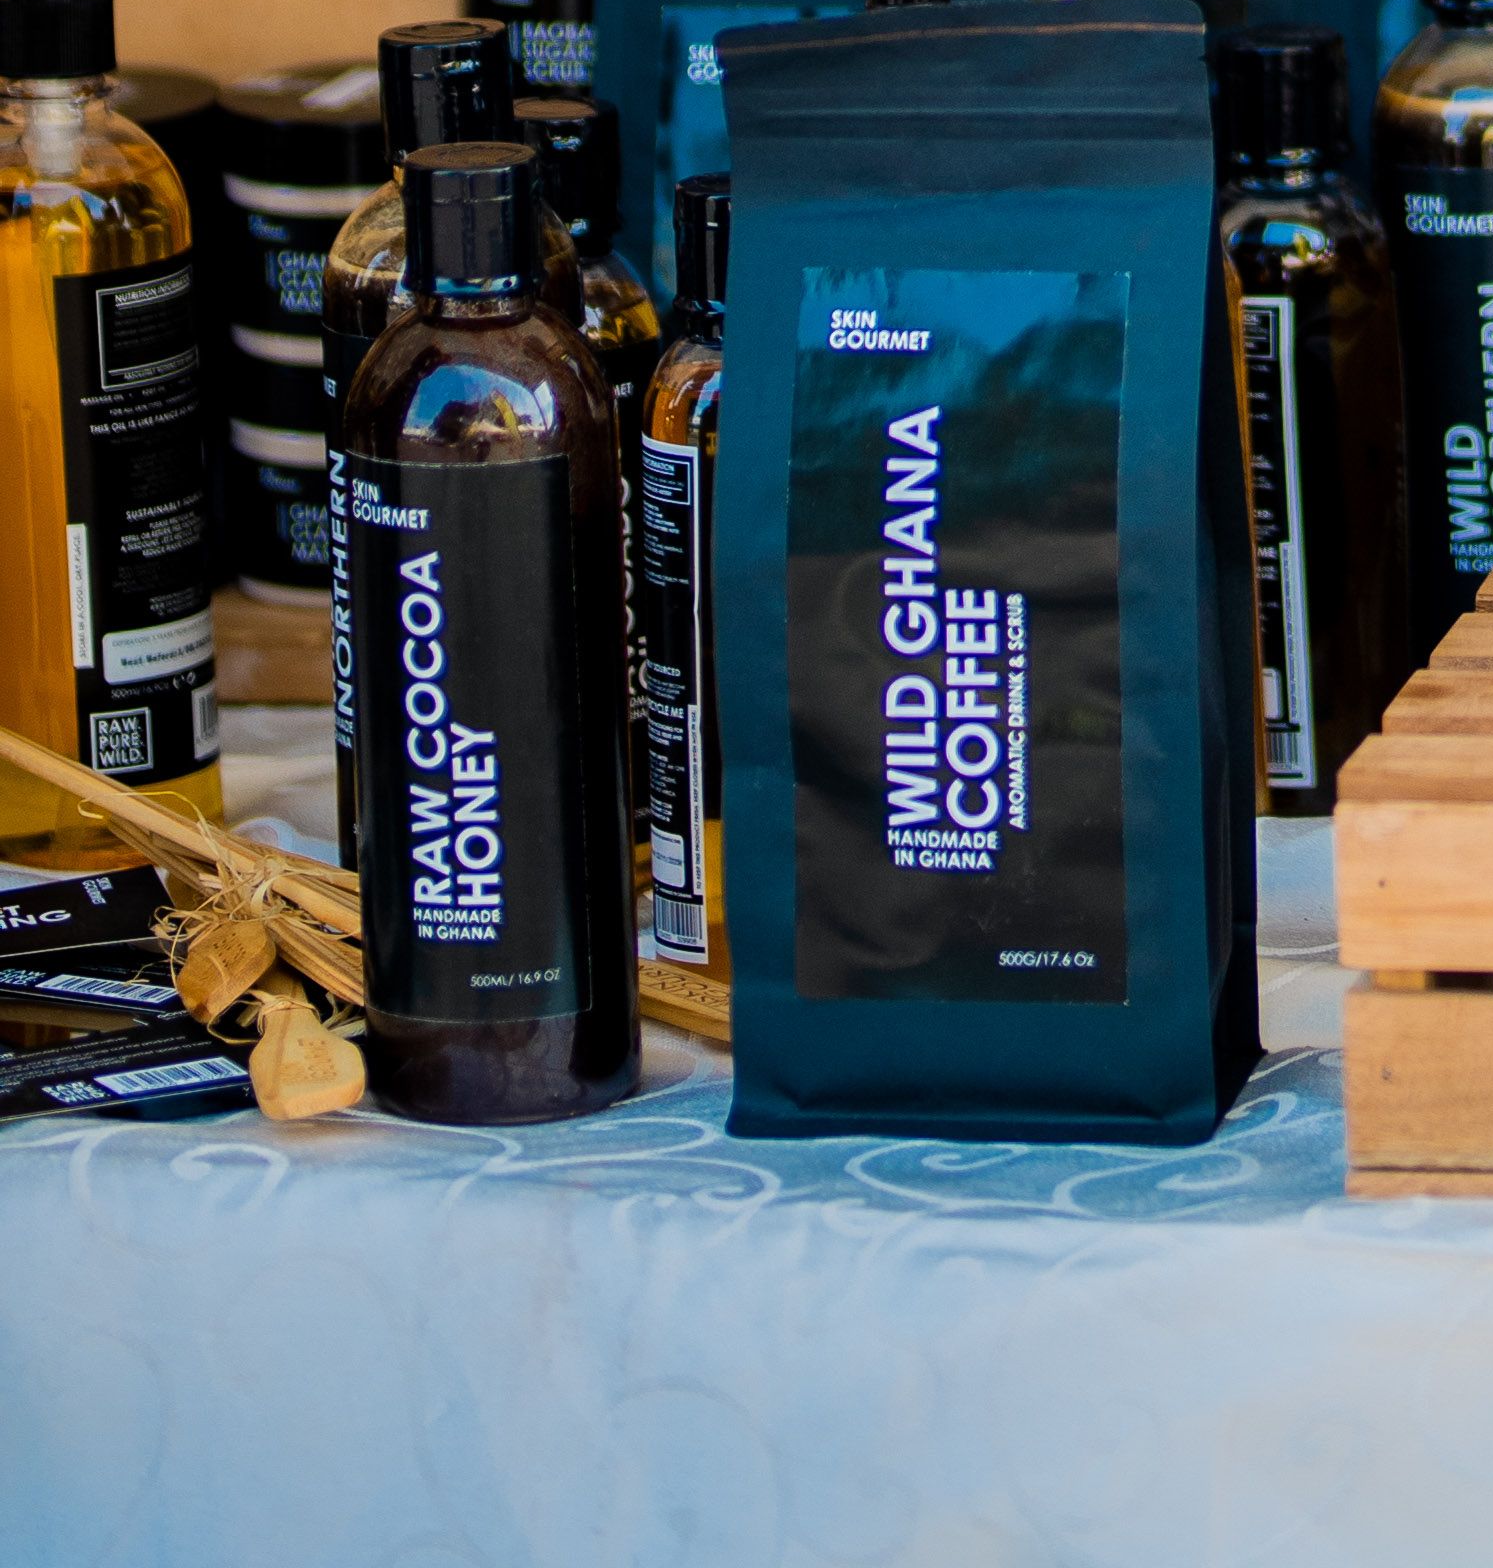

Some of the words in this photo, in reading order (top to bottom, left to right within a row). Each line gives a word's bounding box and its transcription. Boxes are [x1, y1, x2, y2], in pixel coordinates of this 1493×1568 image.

[688, 44, 716, 63] SKI
[1404, 193, 1444, 214] SKIN
[829, 308, 877, 329] SKIN
[829, 328, 930, 352] GOURMET
[352, 478, 380, 502] SKIN
[1445, 424, 1488, 546] WILD
[352, 499, 430, 530] GOURMET
[882, 405, 941, 656] GHANA
[1006, 592, 1026, 651] SCRUB
[400, 550, 444, 770] COCOA
[1007, 654, 1026, 668] &
[944, 587, 999, 829] COFFEE
[1007, 670, 1027, 728] DRINK
[886, 676, 940, 828] WILD
[1008, 731, 1028, 830] AROMATIC
[451, 722, 501, 907] HONEY
[407, 786, 453, 906] RAW
[887, 829, 999, 850] HANDMADE
[894, 849, 917, 868] IN
[919, 849, 994, 871] GHANA
[412, 907, 502, 926] HANDMADE
[417, 924, 434, 939] IN
[435, 925, 498, 942] GHANA
[998, 950, 1073, 969] 500G/17.6
